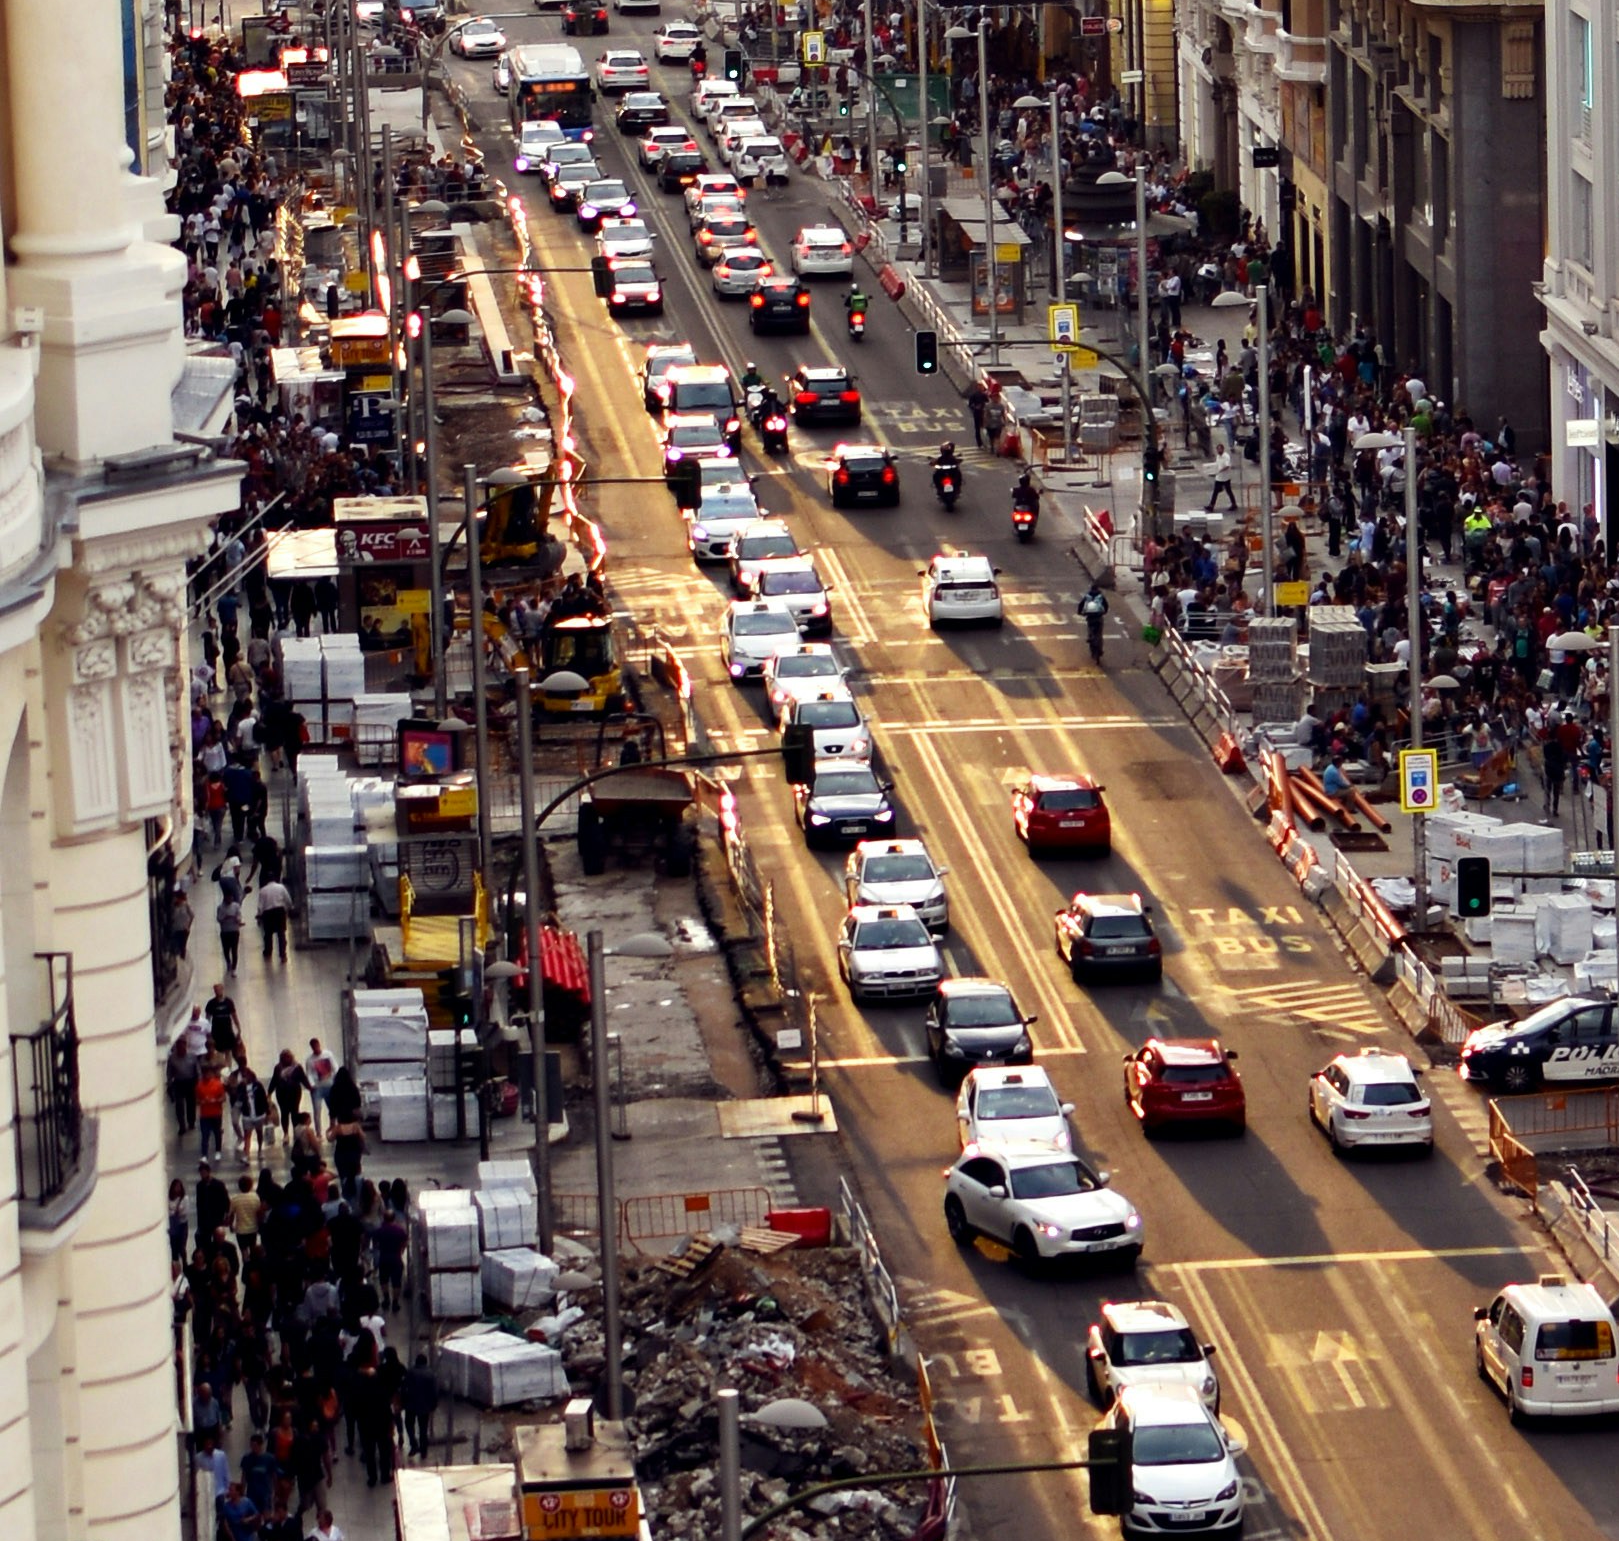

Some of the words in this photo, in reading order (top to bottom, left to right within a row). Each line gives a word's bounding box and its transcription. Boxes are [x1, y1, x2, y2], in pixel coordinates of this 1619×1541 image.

[885, 409, 964, 418] TAXI
[899, 422, 966, 432] BUS
[360, 532, 397, 545] KFC
[1189, 905, 1304, 926] TAXI
[1213, 935, 1312, 954] BUS
